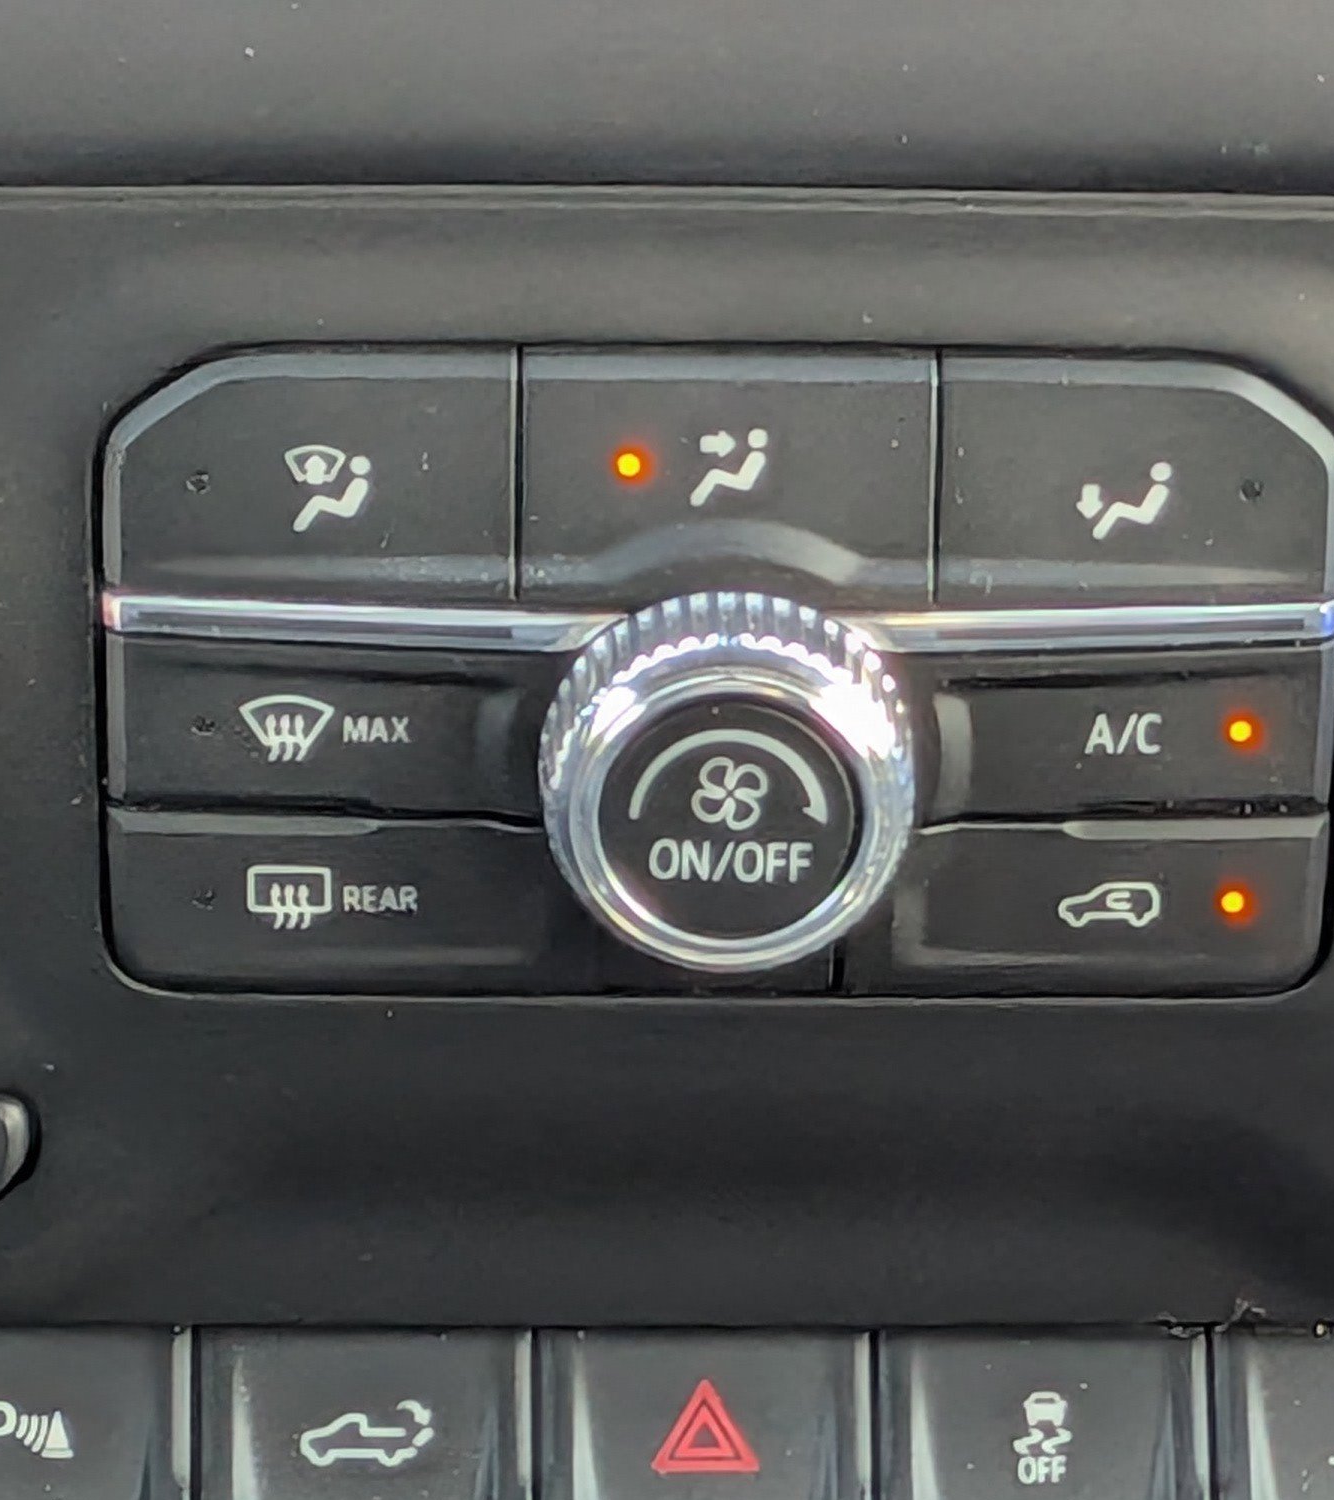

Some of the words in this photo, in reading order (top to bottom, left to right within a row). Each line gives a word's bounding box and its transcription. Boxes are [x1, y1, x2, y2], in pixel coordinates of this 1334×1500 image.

[341, 714, 412, 744] MAX
[1083, 712, 1163, 755] A/C
[647, 837, 814, 883] ON/OFF
[341, 884, 419, 912] REAR
[1017, 1454, 1067, 1485] OFF
